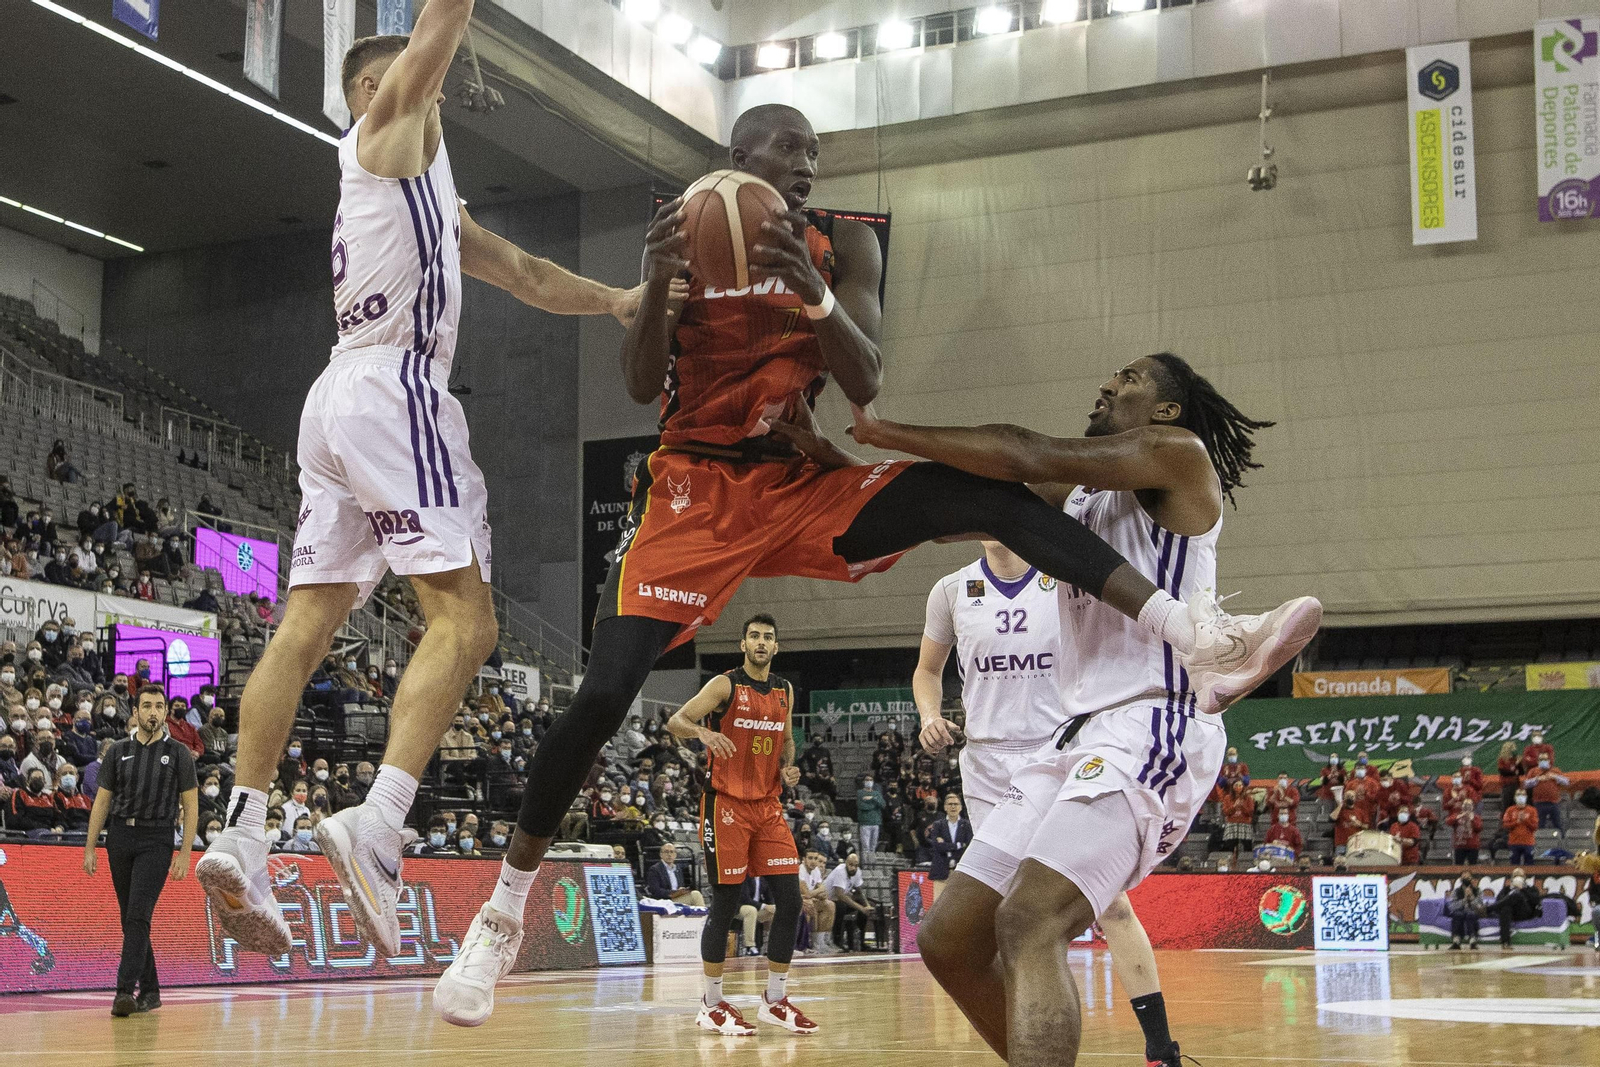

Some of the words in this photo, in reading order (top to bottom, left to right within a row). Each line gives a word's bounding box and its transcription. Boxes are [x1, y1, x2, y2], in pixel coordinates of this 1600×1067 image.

[1540, 86, 1559, 169] Deportes
[1563, 84, 1580, 148] Palacio
[1451, 105, 1467, 198] cidesur
[1564, 152, 1582, 175] de
[1419, 110, 1440, 229] ASCENSORES
[774, 307, 801, 340] 7
[655, 586, 707, 607] BERNER
[995, 608, 1029, 636] 32
[974, 652, 1054, 673] UEMC
[1314, 677, 1391, 695] Granada
[850, 702, 883, 714] CAJA
[886, 701, 917, 714] RUR
[752, 735, 773, 755] 50
[1248, 715, 1400, 750] FRENTE
